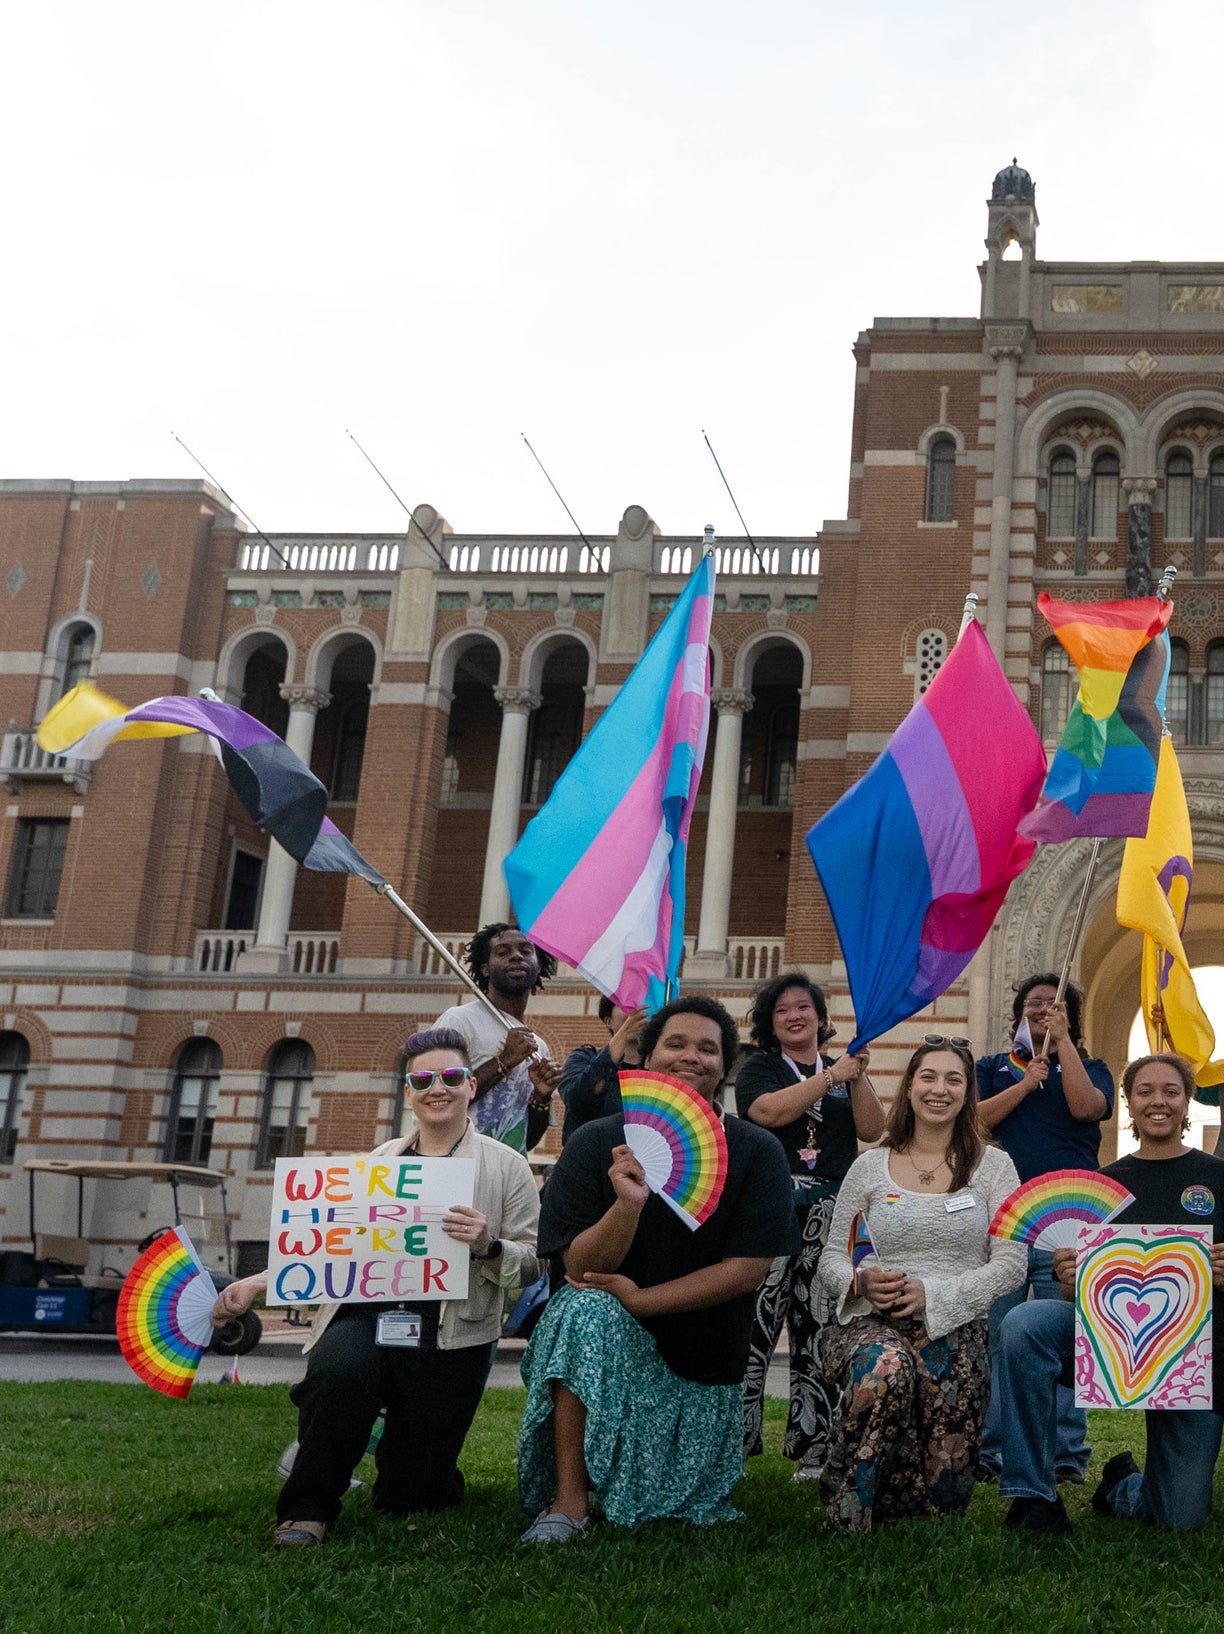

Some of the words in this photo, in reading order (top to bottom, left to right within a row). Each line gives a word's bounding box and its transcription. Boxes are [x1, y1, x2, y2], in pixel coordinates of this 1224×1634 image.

[285, 1160, 423, 1202] WE'RE
[281, 1204, 450, 1224] HERE
[278, 1225, 428, 1256] WE'RE
[276, 1257, 450, 1301] QUEER
